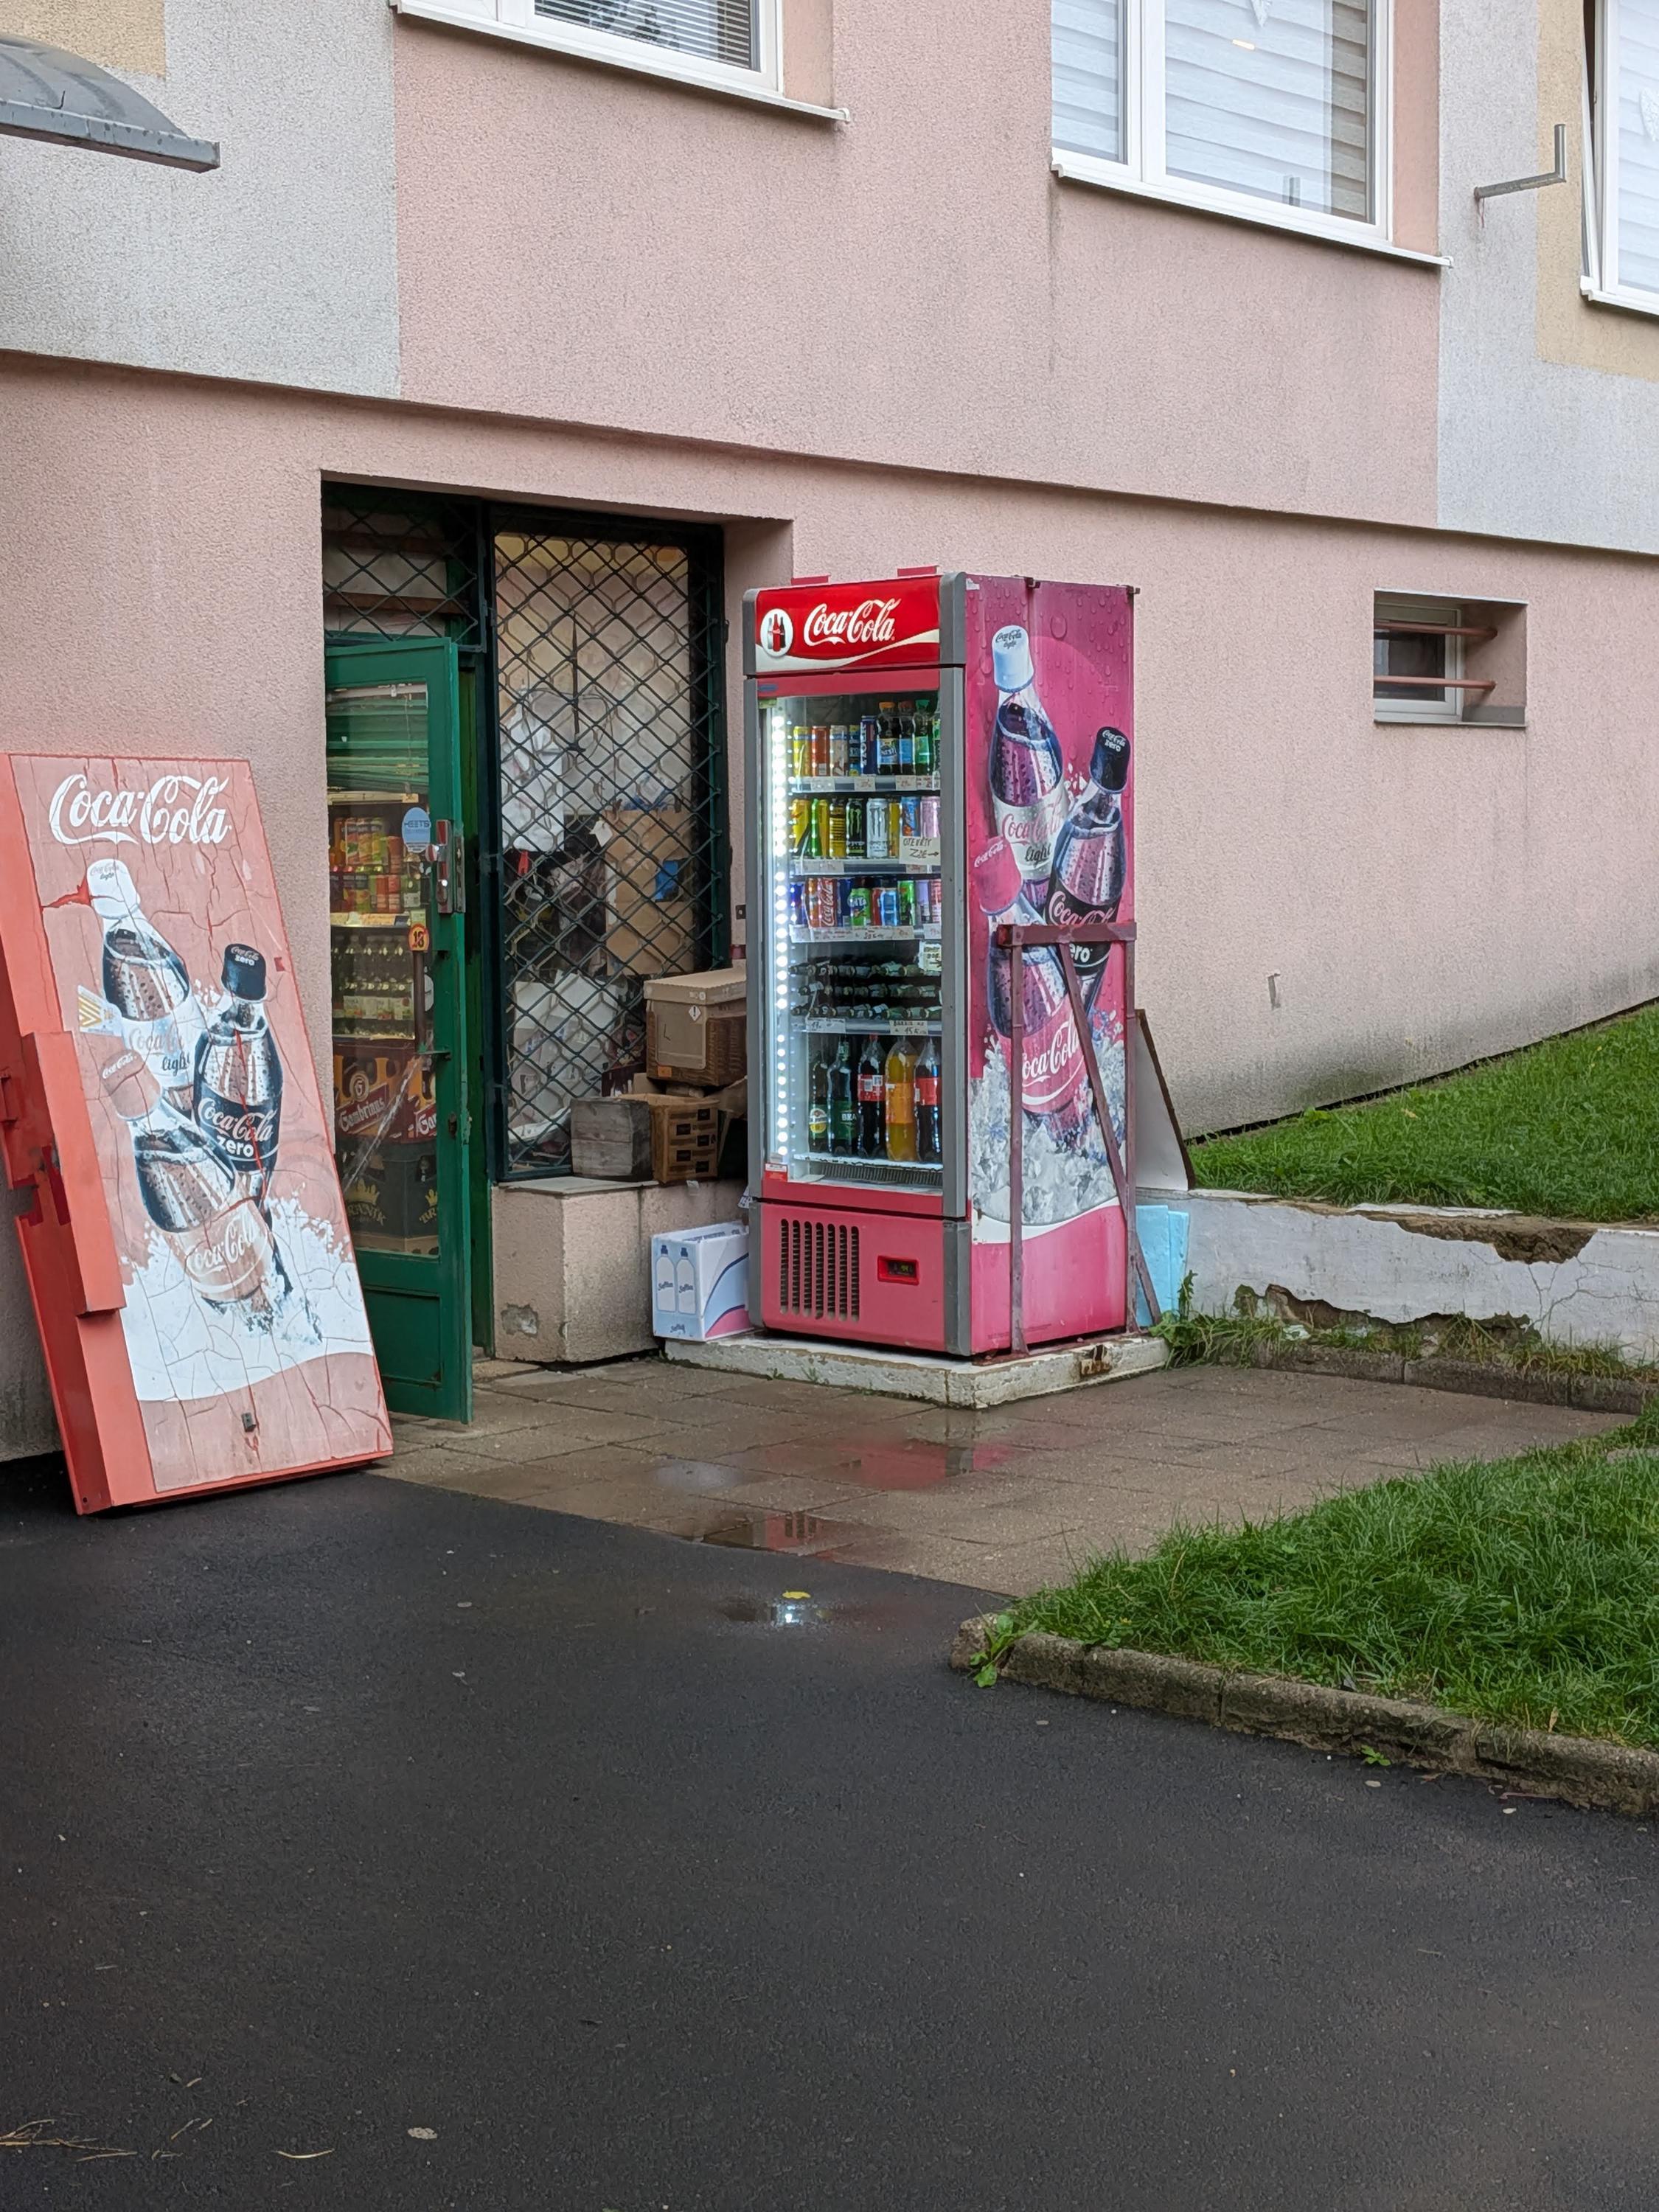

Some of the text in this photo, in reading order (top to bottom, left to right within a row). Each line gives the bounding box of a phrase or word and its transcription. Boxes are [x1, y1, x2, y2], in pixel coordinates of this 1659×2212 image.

[804, 598, 902, 646] Coca-Cola
[995, 628, 1022, 643] Coca-Cola
[1102, 729, 1127, 747] Coca-Cola
[49, 773, 232, 845] Coca-Cola
[414, 931, 424, 948] 18
[235, 954, 255, 967] zero
[1069, 943, 1091, 963] ero
[1022, 1013, 1080, 1088] oca-Cola
[102, 1052, 134, 1079] Coca-Cola
[198, 1098, 278, 1142] Coca-Cola
[217, 1135, 254, 1158] zero
